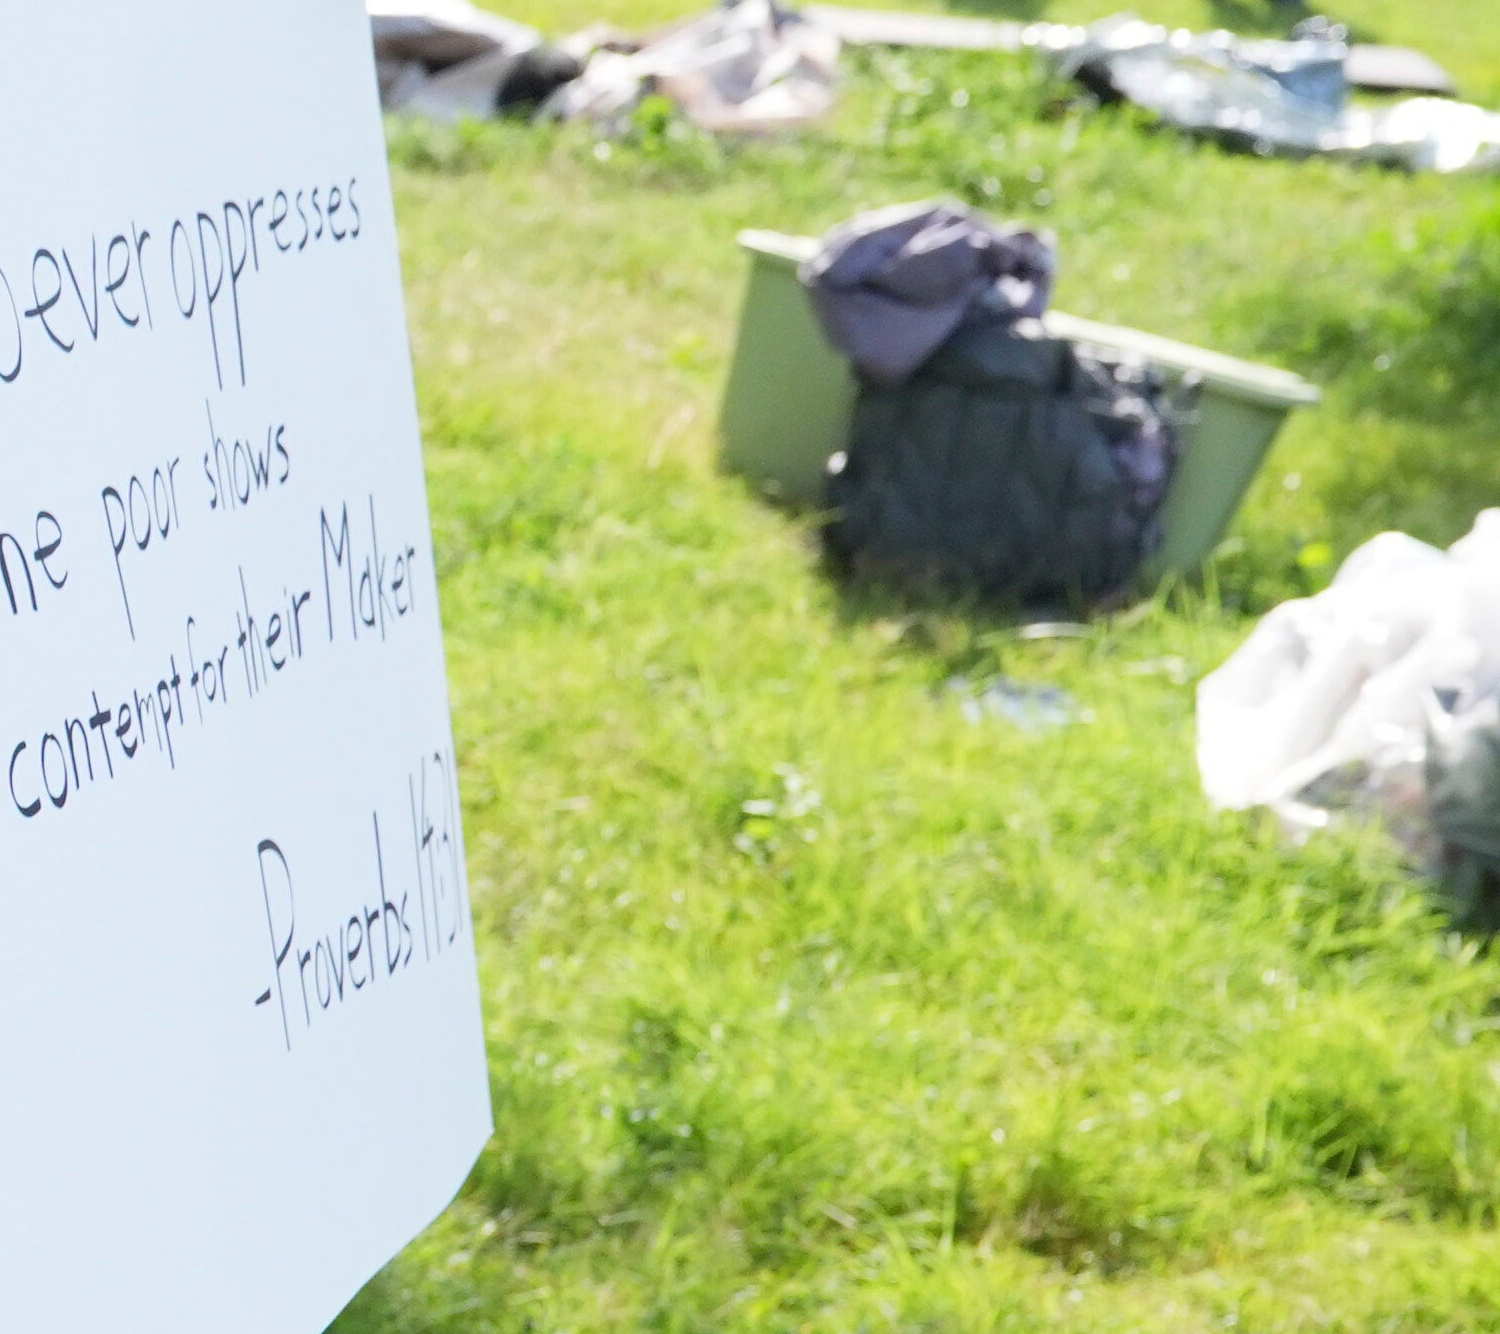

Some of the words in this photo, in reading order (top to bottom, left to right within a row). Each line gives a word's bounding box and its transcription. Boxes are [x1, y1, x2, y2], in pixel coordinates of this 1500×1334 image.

[170, 176, 361, 392] oppresses
[100, 455, 181, 643] poor
[203, 397, 291, 511] shows
[8, 652, 185, 819] contempt
[186, 614, 229, 727] for
[235, 564, 312, 699] their
[319, 493, 416, 644] Maker
[253, 809, 413, 1053] -Proverbs
